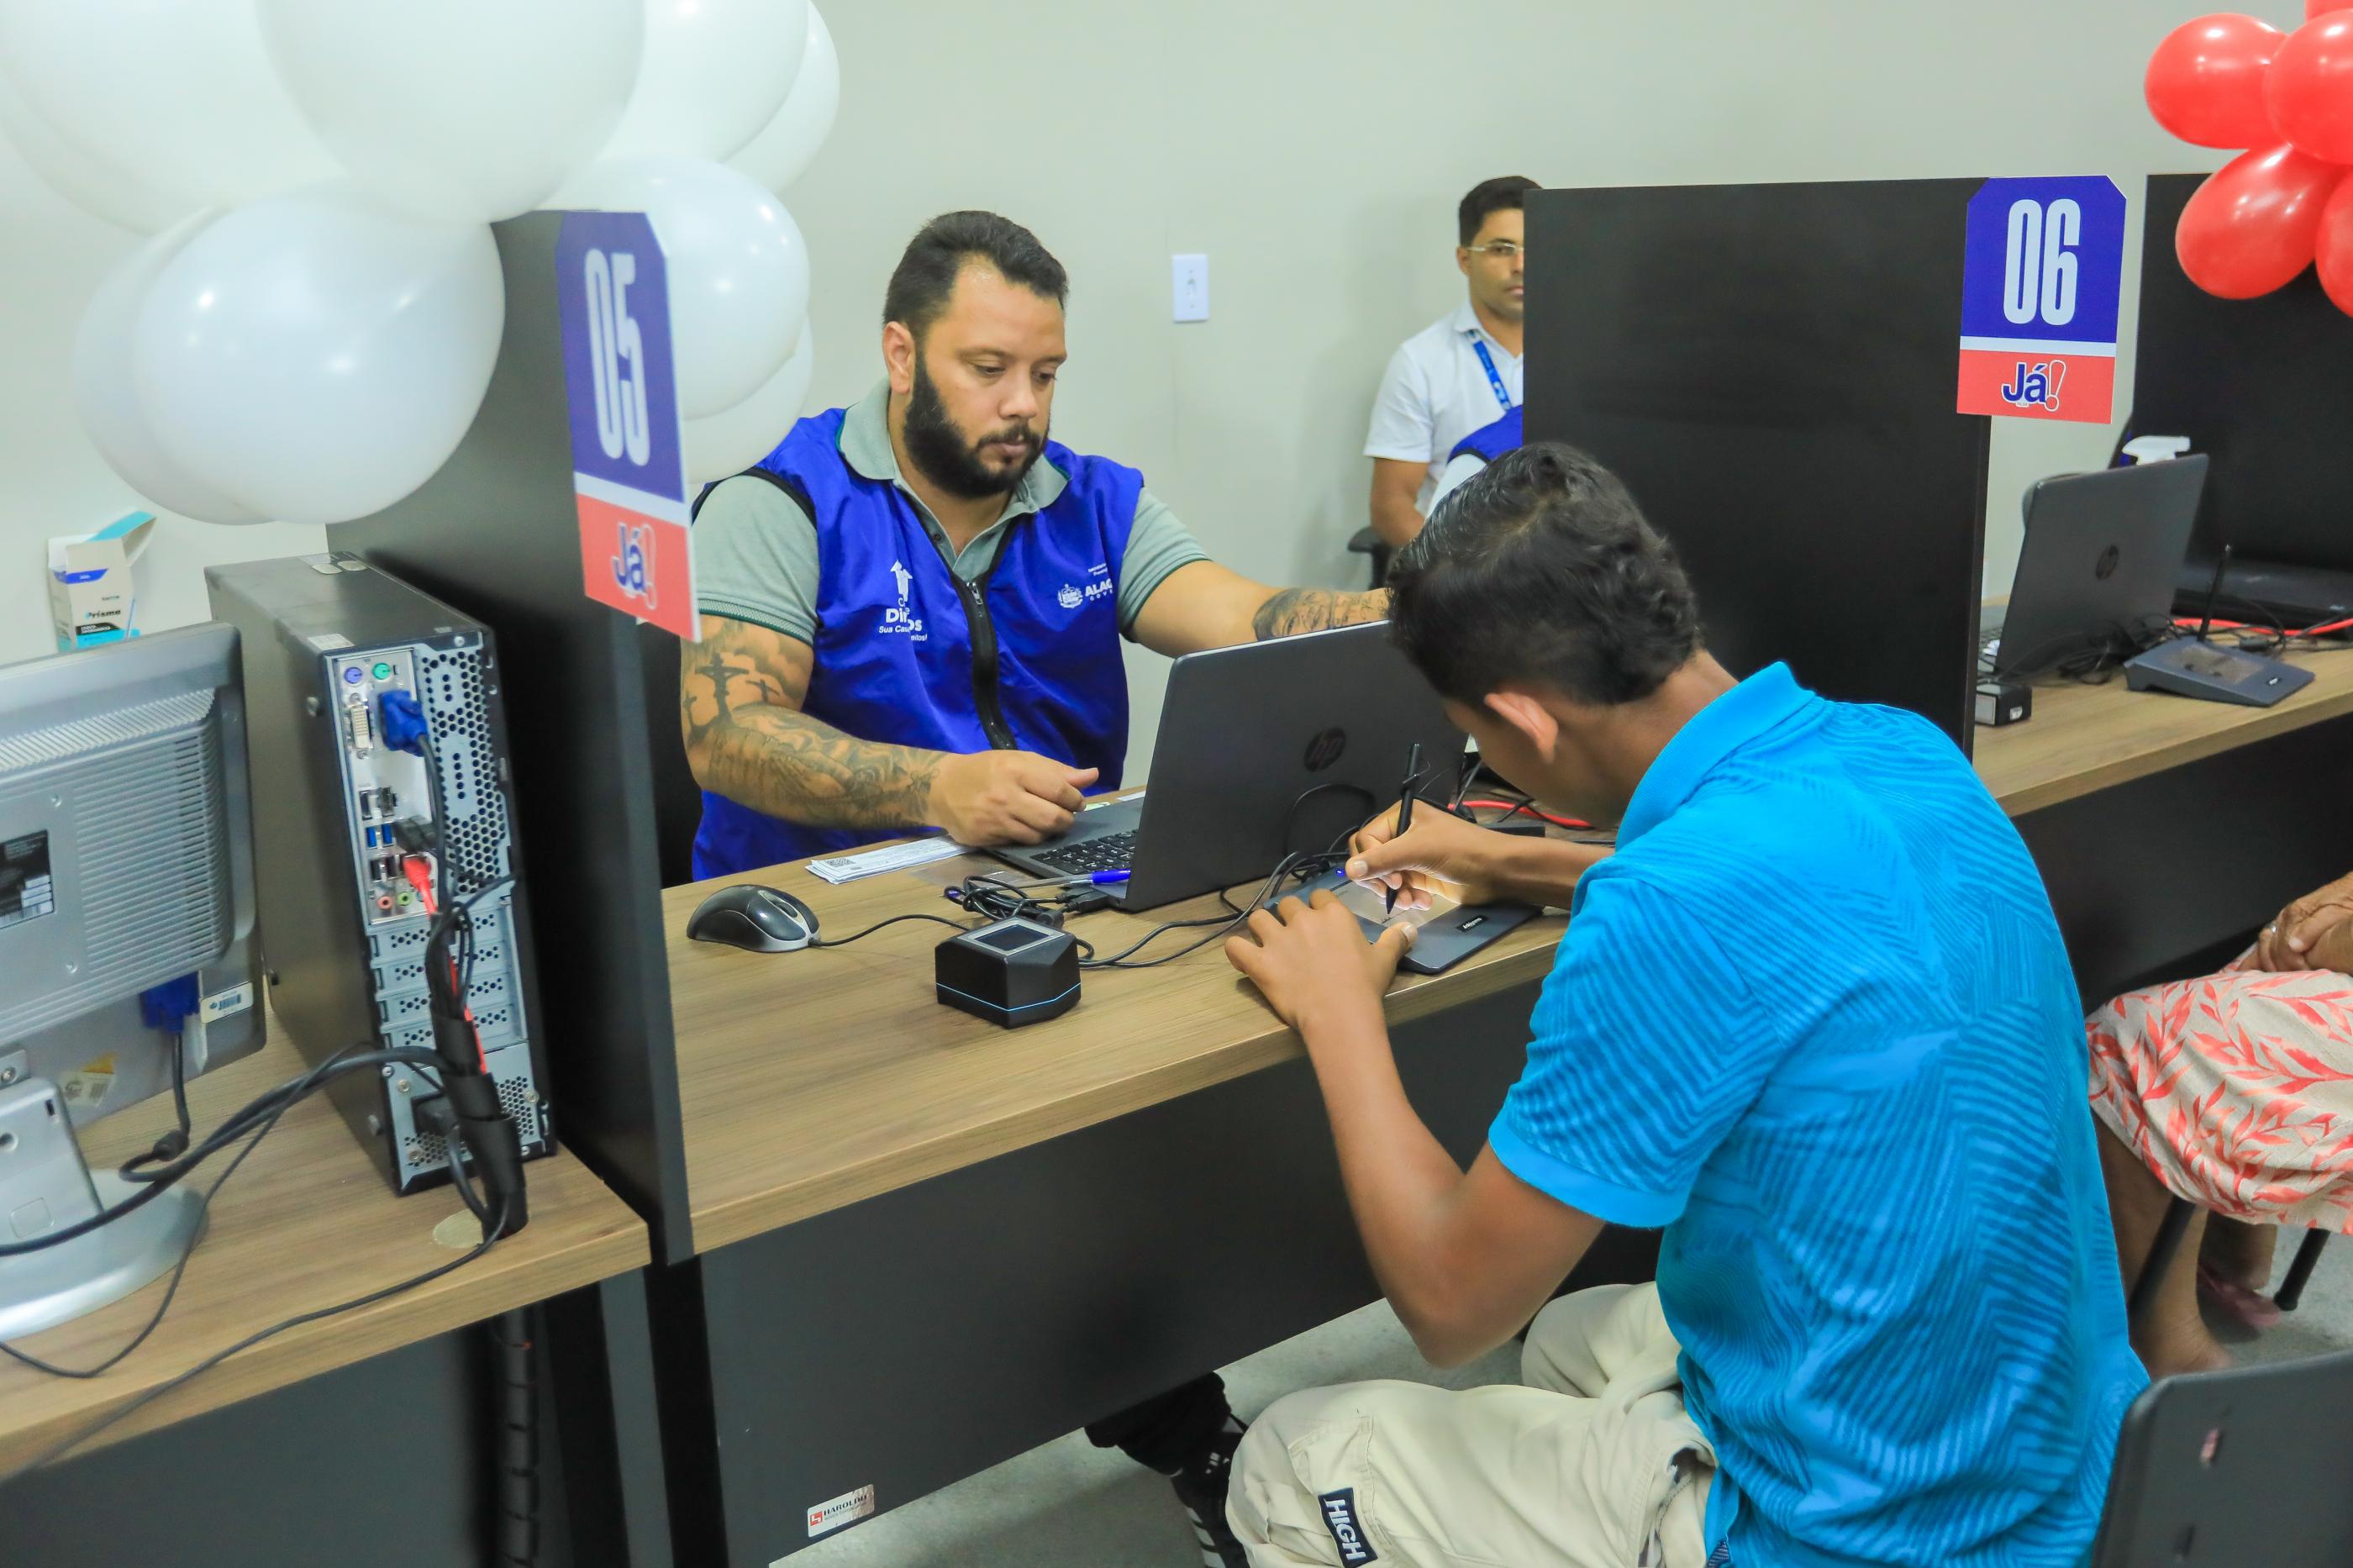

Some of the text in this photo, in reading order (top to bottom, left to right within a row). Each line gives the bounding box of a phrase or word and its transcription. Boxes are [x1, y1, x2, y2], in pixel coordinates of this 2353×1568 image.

[2003, 198, 2081, 326] 06
[585, 248, 650, 466] 05
[2001, 360, 2066, 412] Já!
[611, 521, 657, 610] Já!
[1307, 730, 1345, 771] hp
[1324, 1499, 1366, 1560] HIGH
